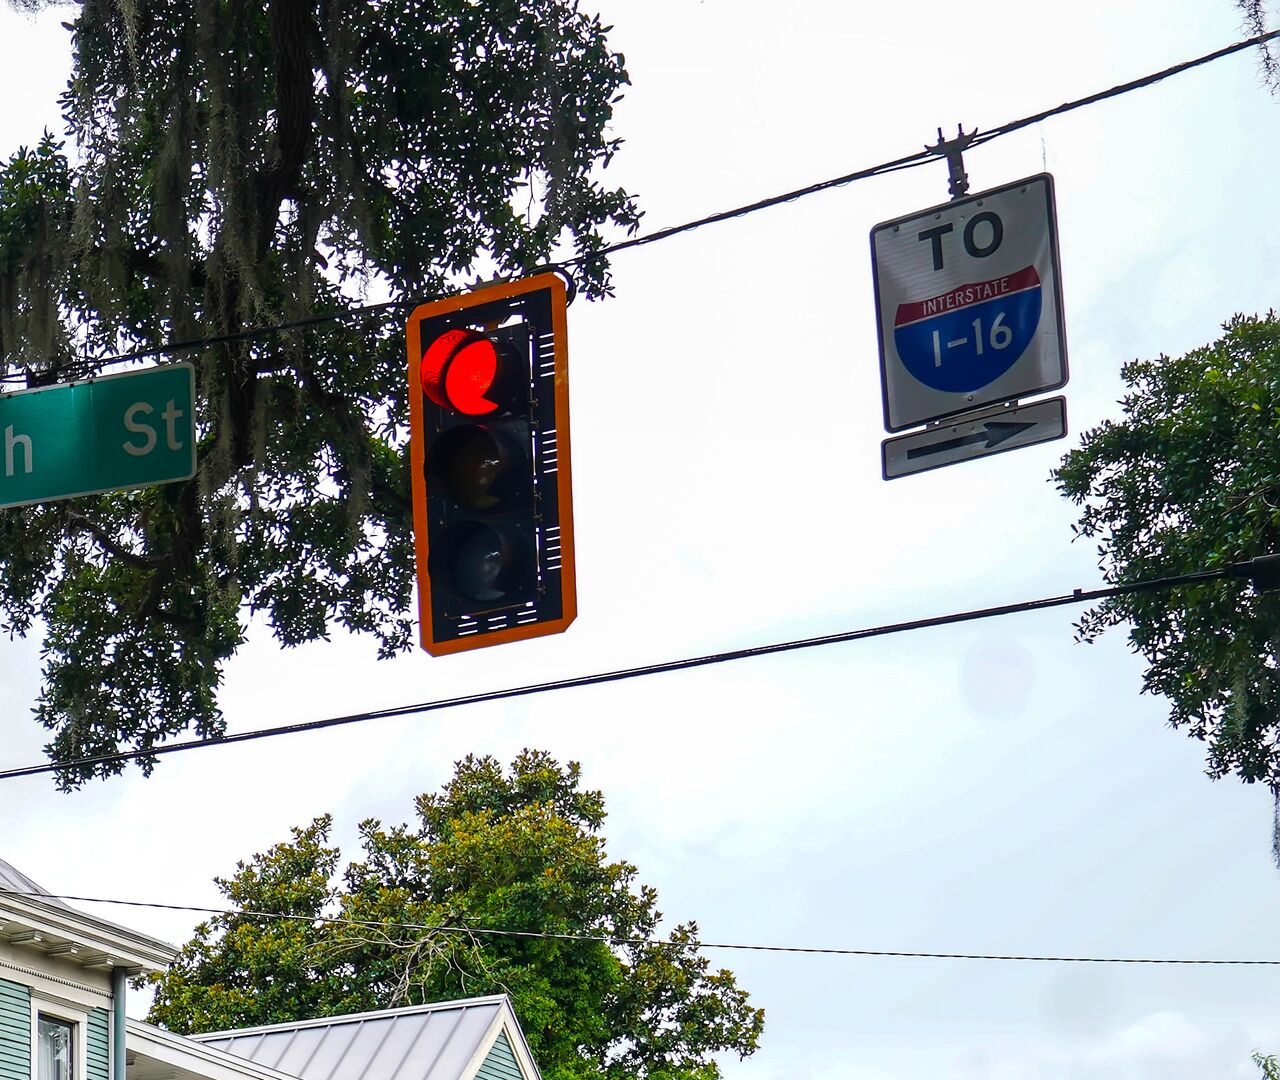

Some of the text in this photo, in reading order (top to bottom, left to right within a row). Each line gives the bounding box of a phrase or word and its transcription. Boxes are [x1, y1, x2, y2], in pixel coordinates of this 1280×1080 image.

[917, 210, 1004, 272] TO
[922, 277, 1010, 316] INTERSTATE
[932, 311, 1013, 368] I-16
[121, 398, 184, 456] St
